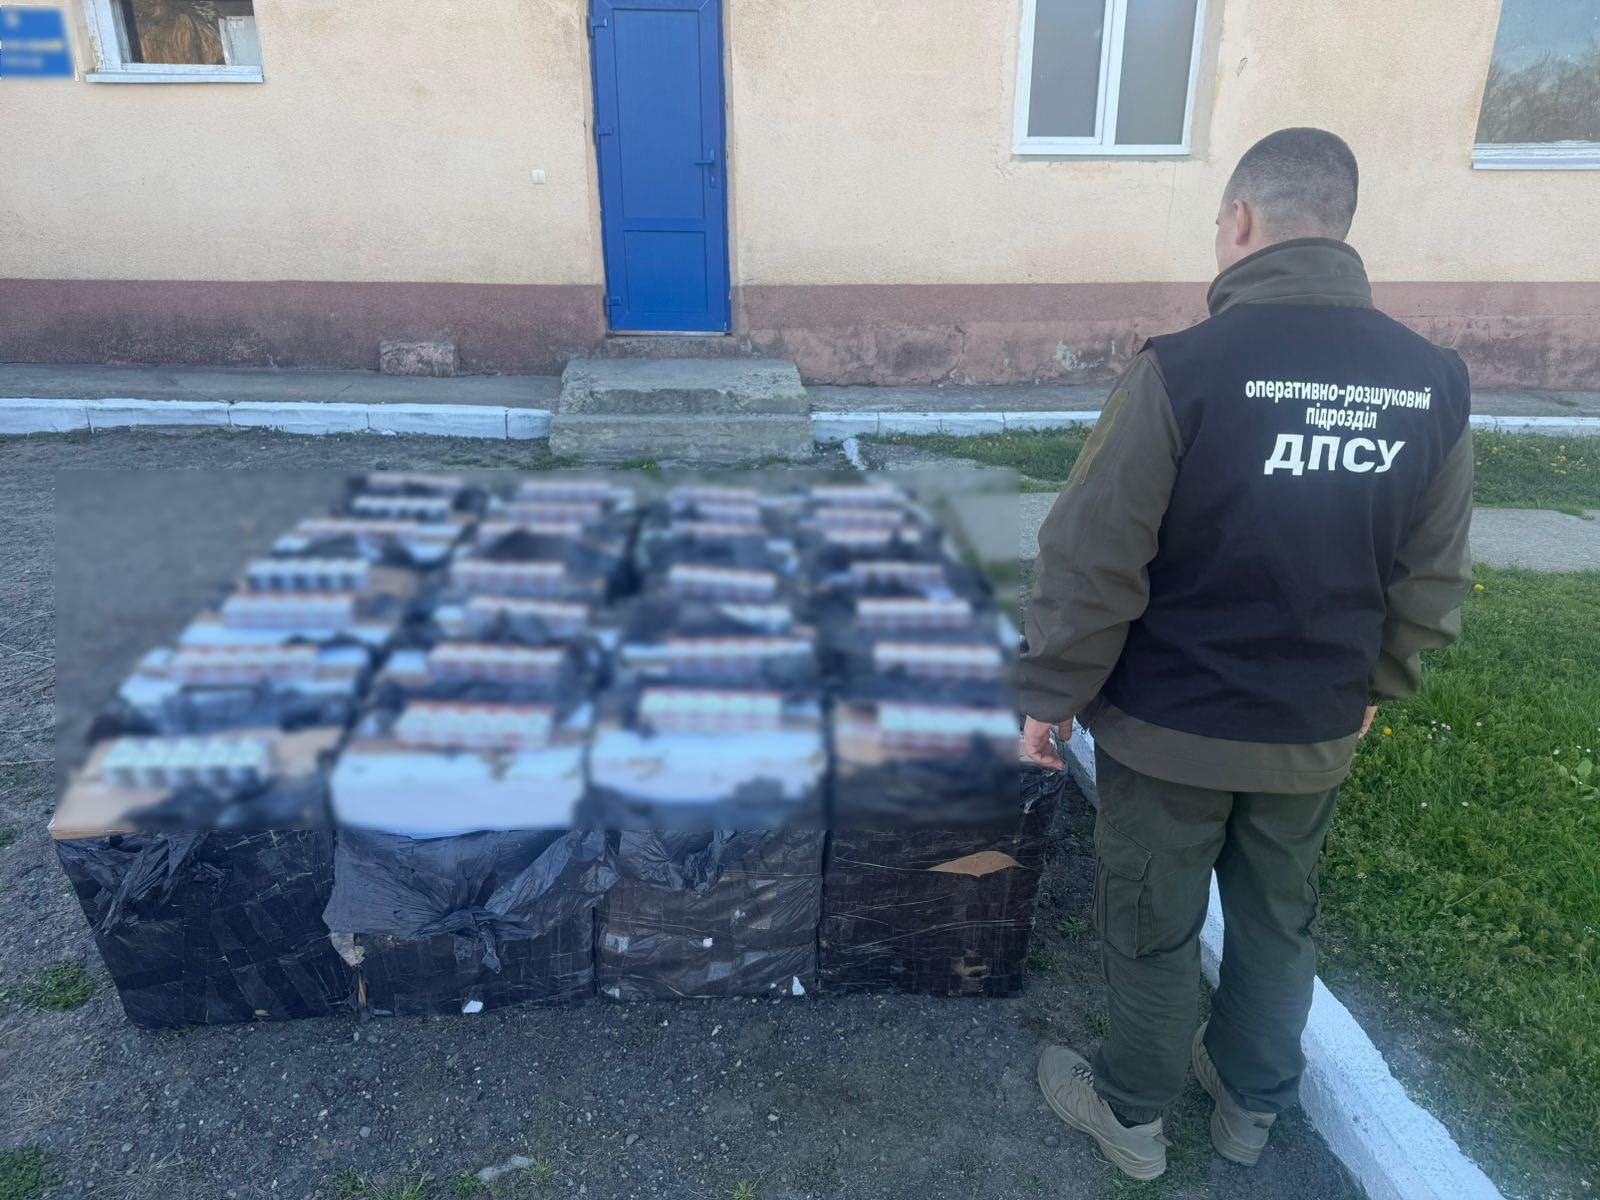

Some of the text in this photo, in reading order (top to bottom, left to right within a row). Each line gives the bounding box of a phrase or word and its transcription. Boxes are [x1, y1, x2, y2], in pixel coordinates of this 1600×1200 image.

[1245, 380, 1432, 410] оперативно-розшуковий
[1305, 403, 1378, 431] підрозділ
[1263, 433, 1406, 476] ДПСУ
